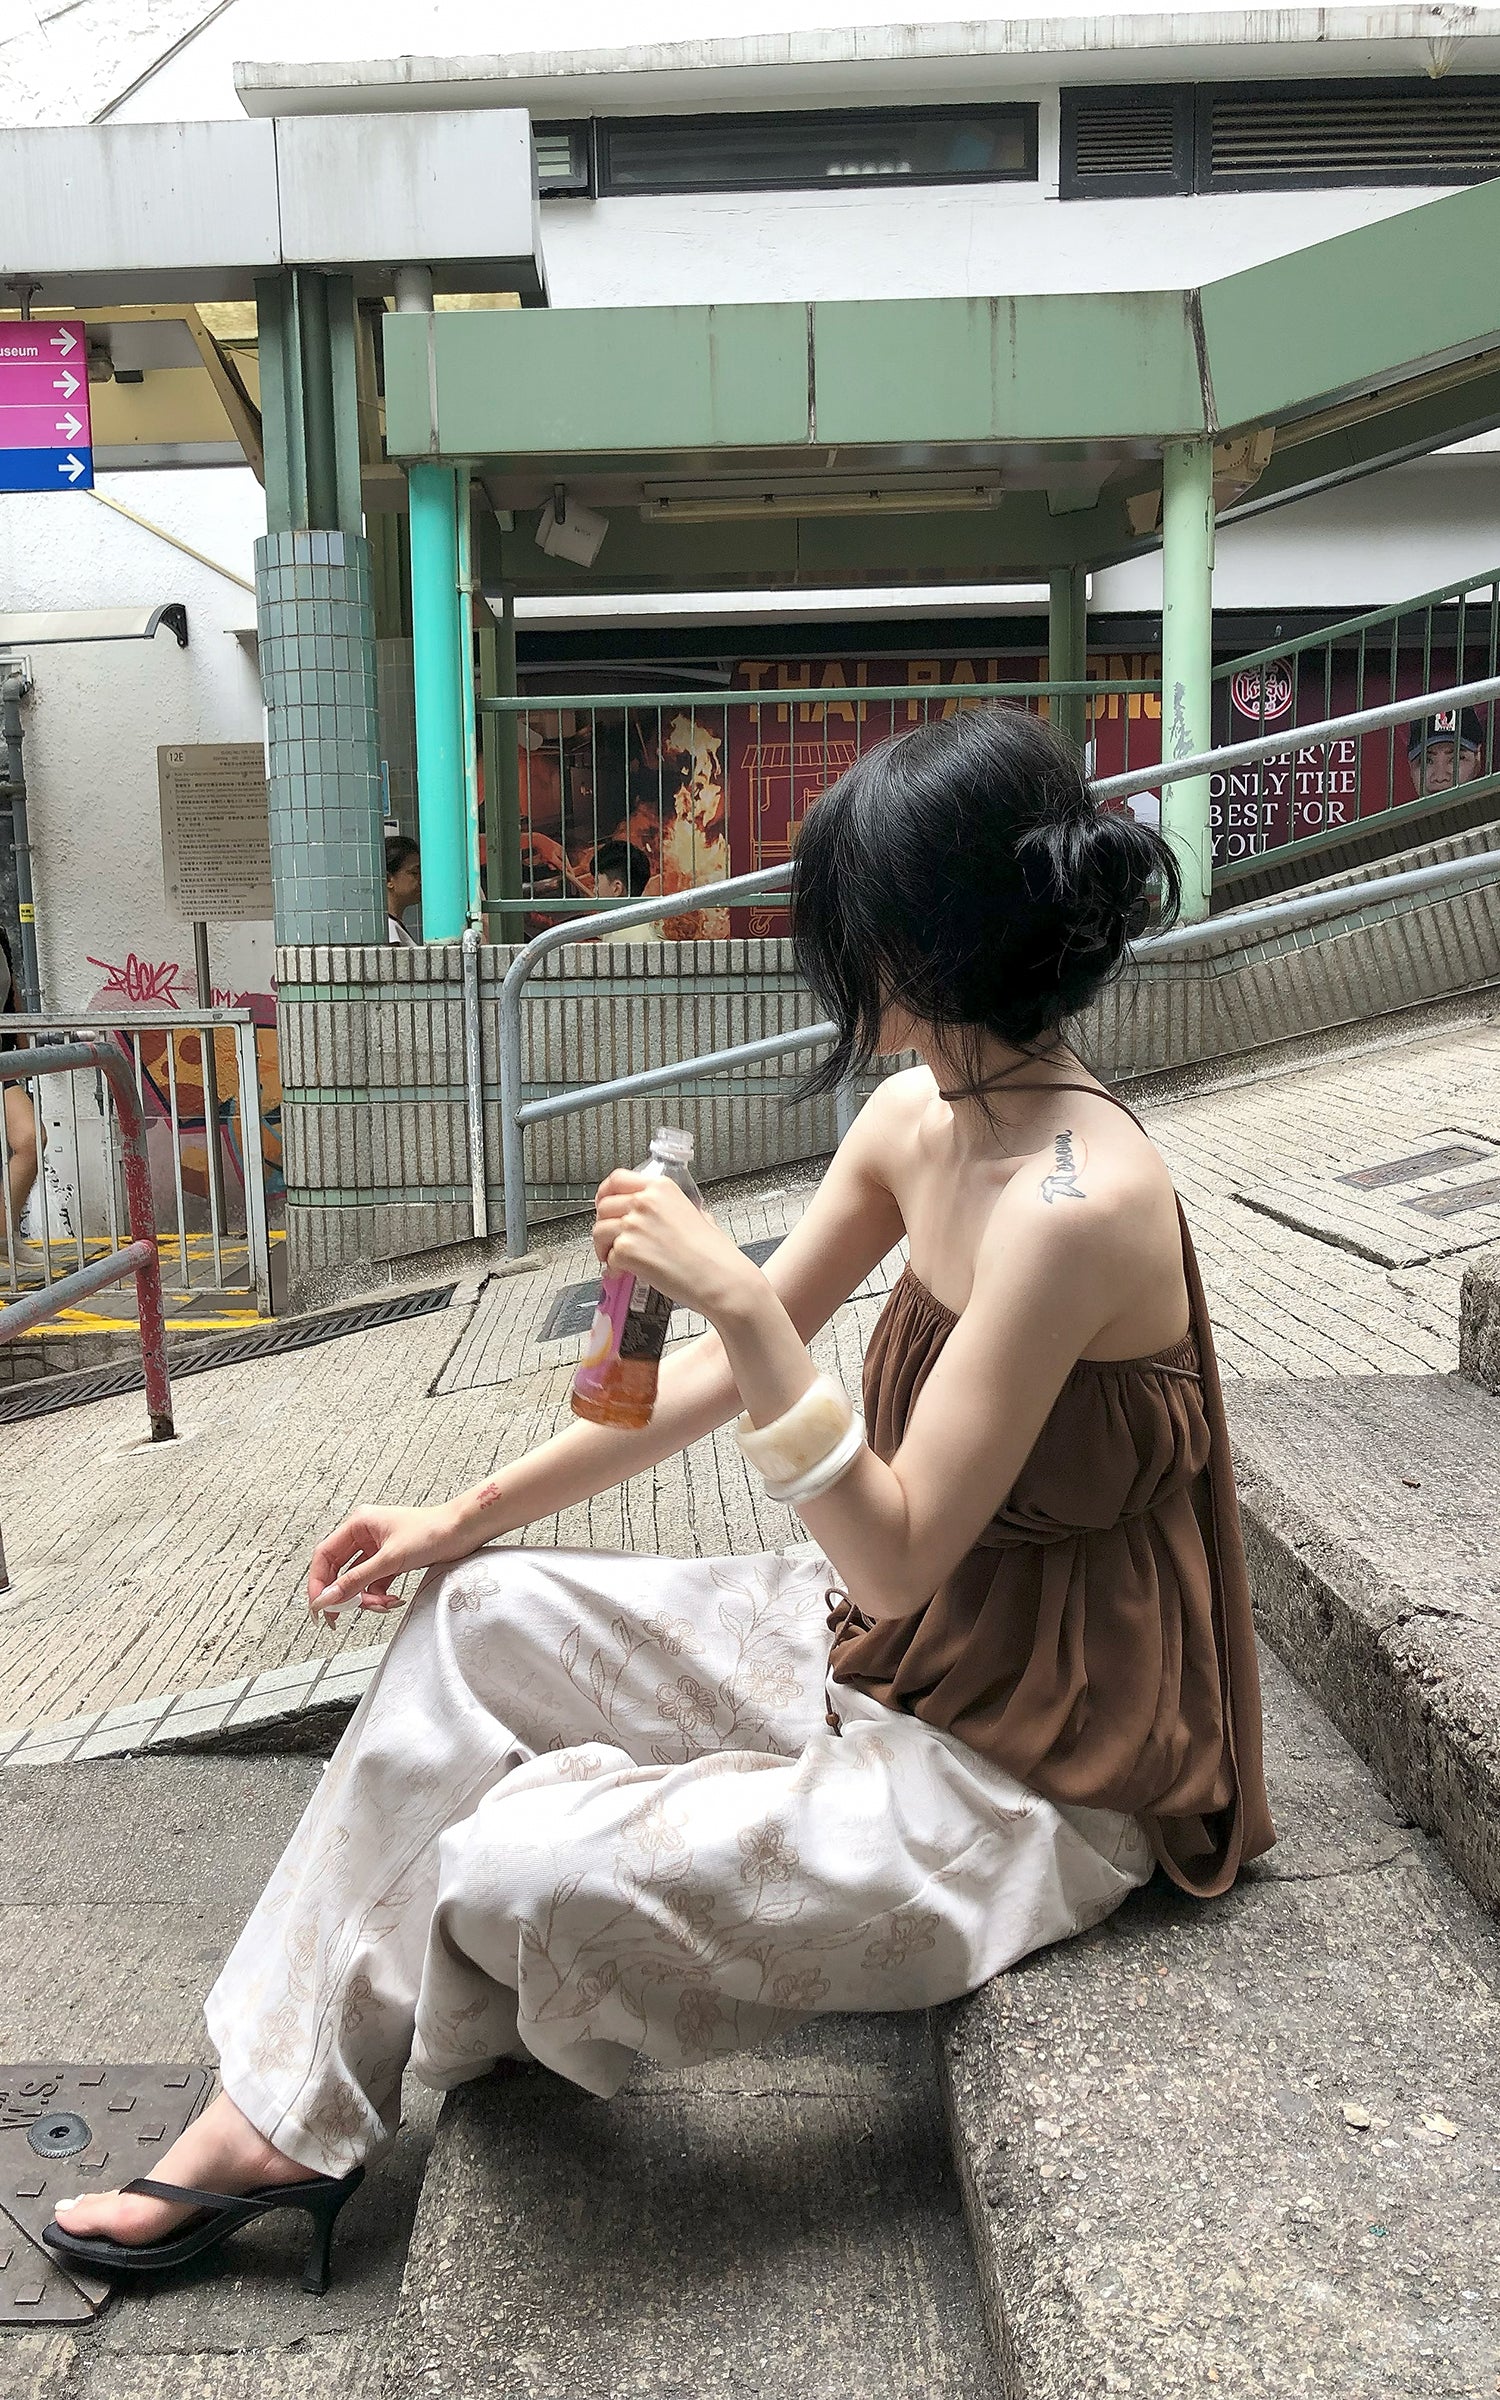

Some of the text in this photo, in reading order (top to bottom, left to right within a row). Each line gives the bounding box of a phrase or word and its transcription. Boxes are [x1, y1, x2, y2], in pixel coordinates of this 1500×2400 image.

[739, 661, 868, 722] THAI
[169, 752, 184, 762] 12E
[1209, 770, 1356, 798] ONLY THE
[1209, 800, 1347, 827] BEST FOR
[1210, 832, 1270, 858] YOU
